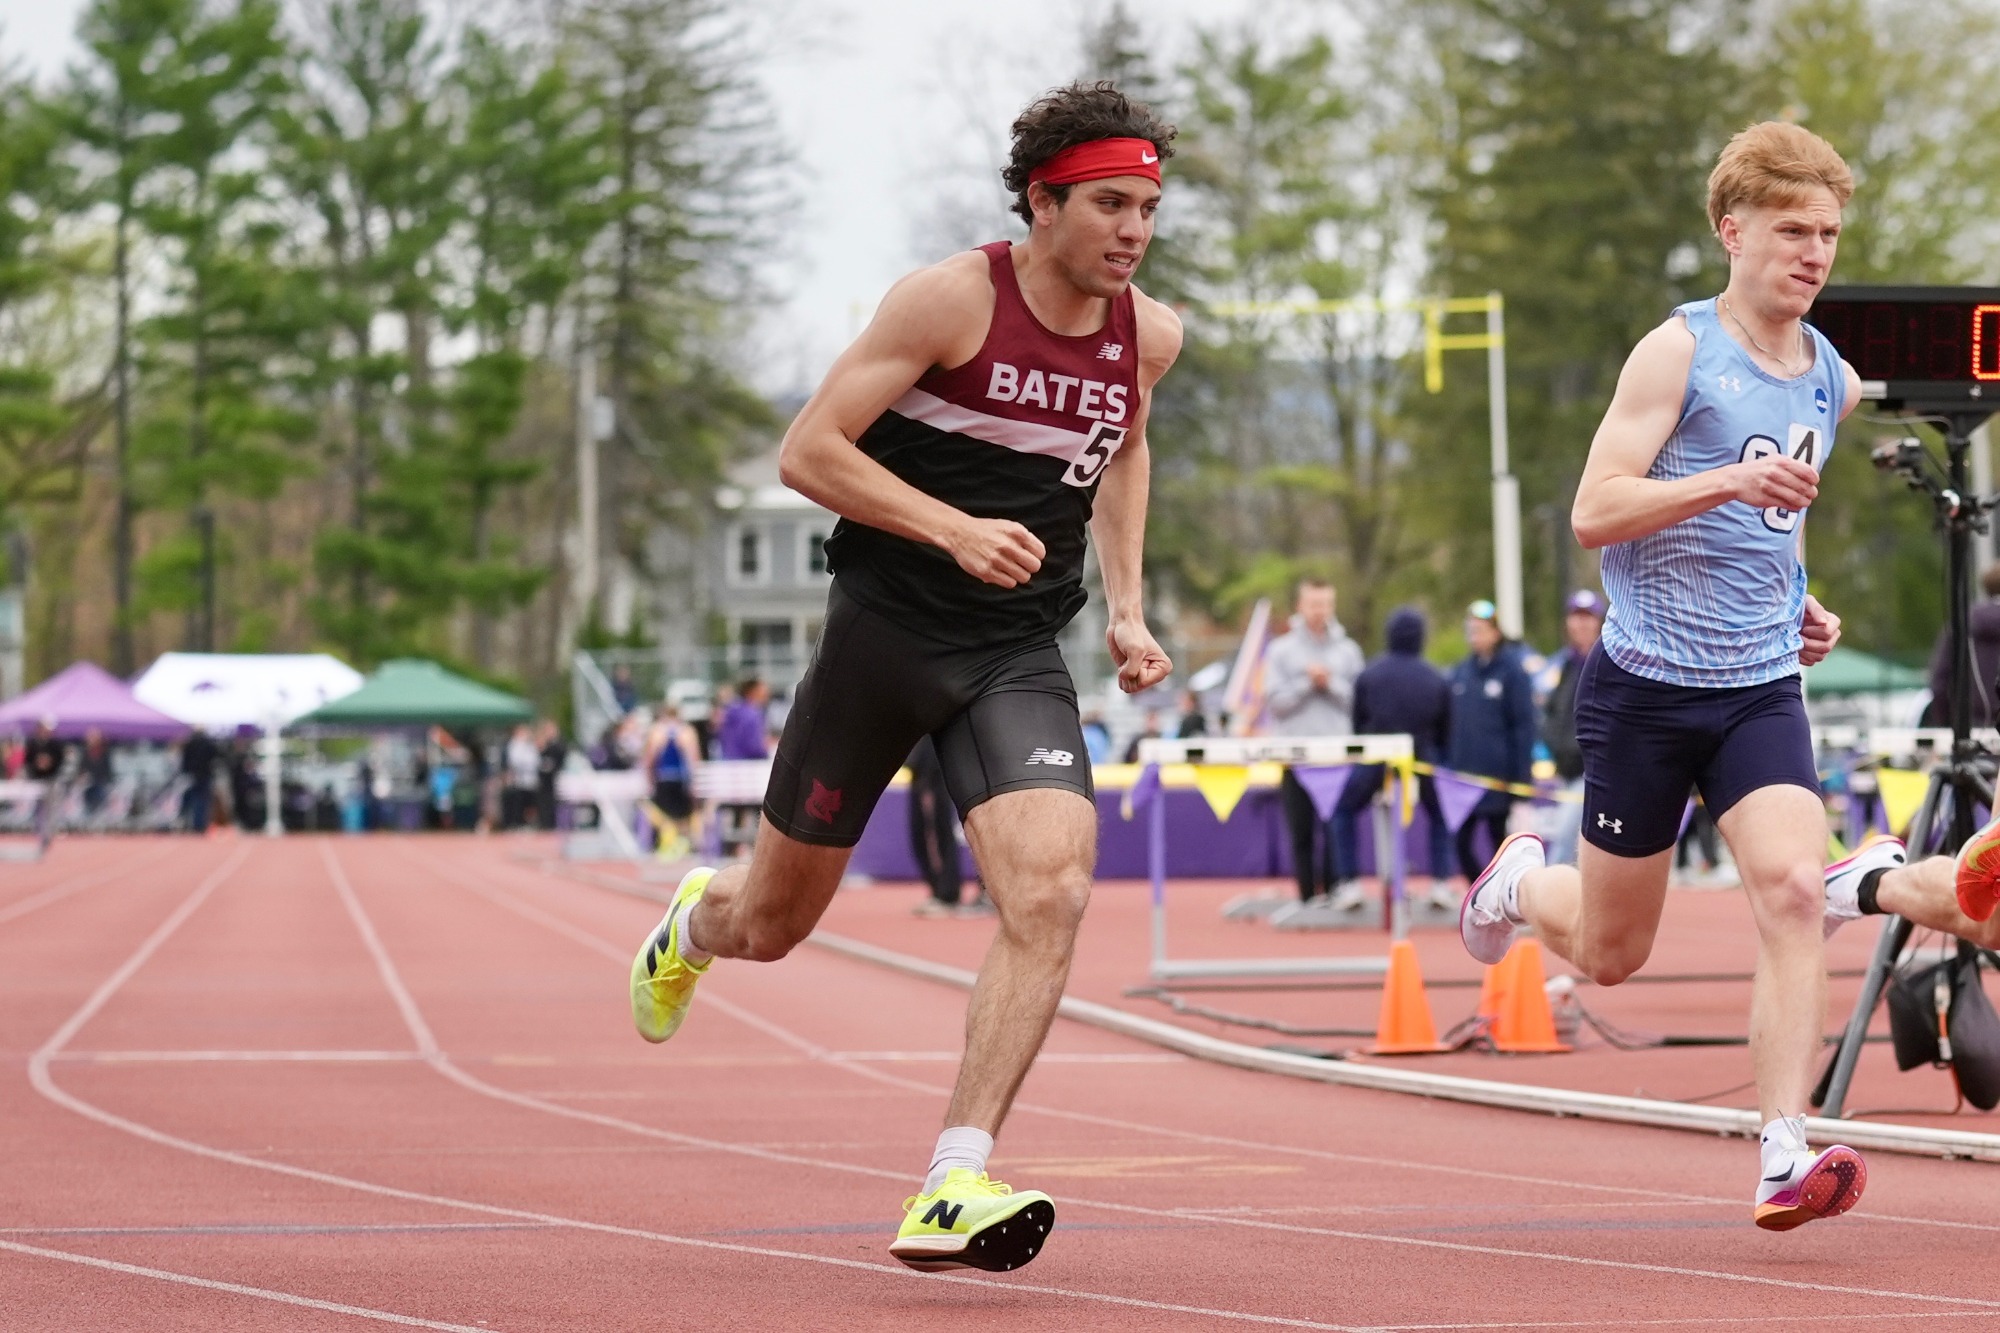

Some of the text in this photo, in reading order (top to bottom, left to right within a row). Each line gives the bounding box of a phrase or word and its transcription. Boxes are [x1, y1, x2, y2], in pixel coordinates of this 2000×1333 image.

[985, 362, 1128, 422] BATES
[1073, 426, 1122, 482] 5
[920, 1199, 964, 1230] N
